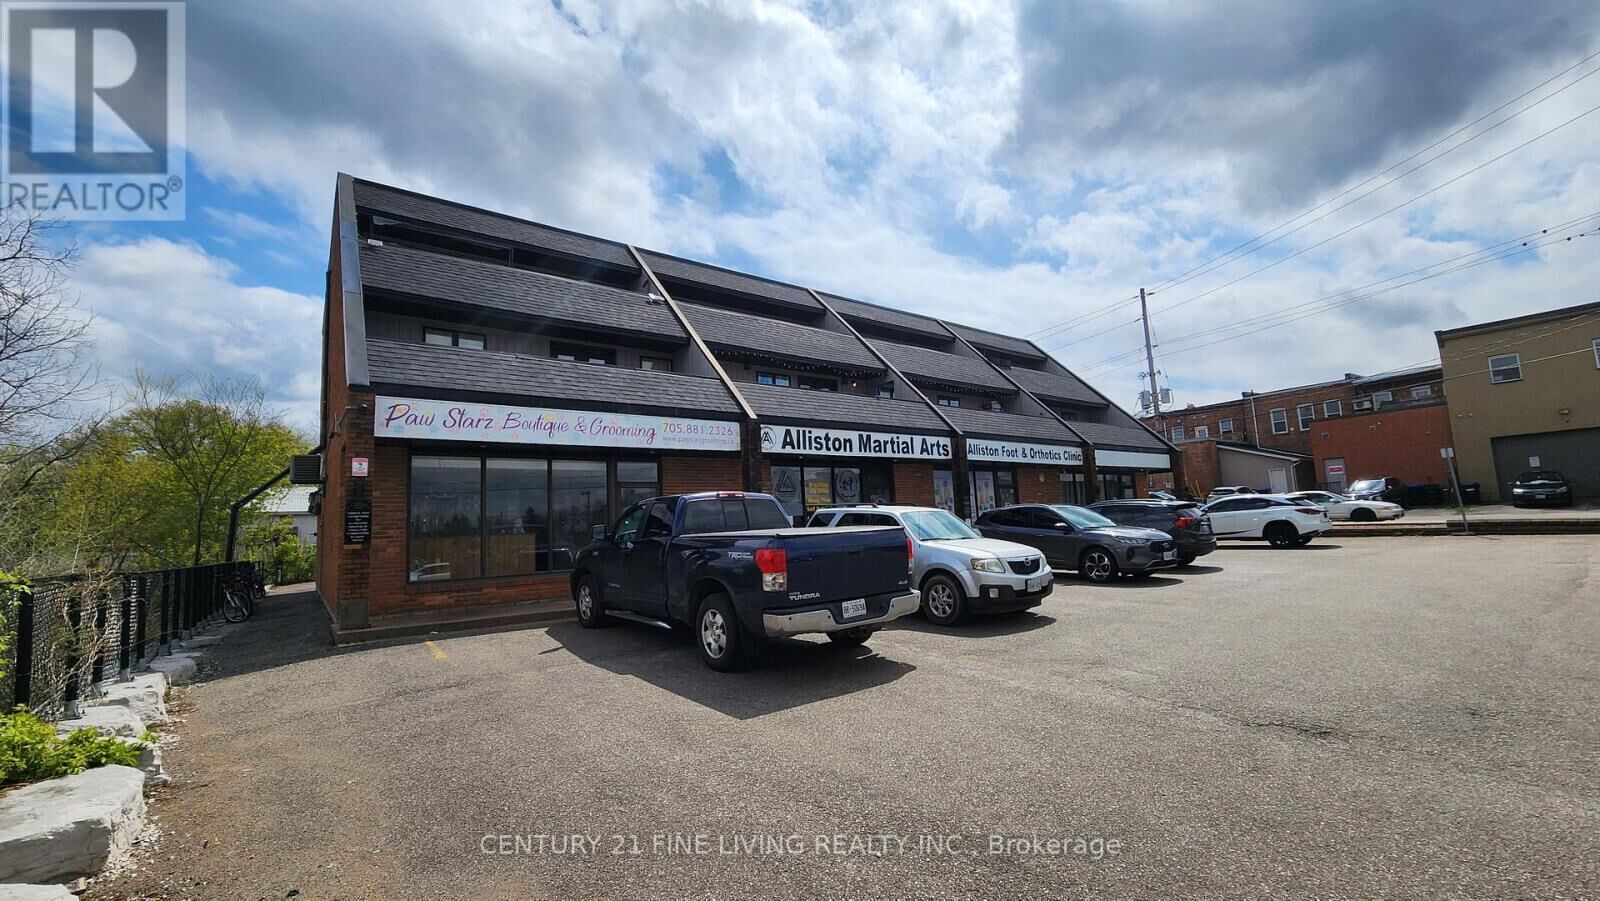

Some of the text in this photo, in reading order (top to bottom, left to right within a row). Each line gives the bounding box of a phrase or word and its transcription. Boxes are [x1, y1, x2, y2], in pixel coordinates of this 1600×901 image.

[384, 403, 657, 445] Paw Starz Boutique & Grooming
[663, 423, 733, 436] 705.881.2326
[781, 428, 853, 453] Alliston
[858, 433, 915, 455] Martial
[919, 437, 951, 457] Arts
[967, 442, 1083, 462] Alliston Foot & Orthotics Clinic
[788, 592, 821, 601] TUNDRA
